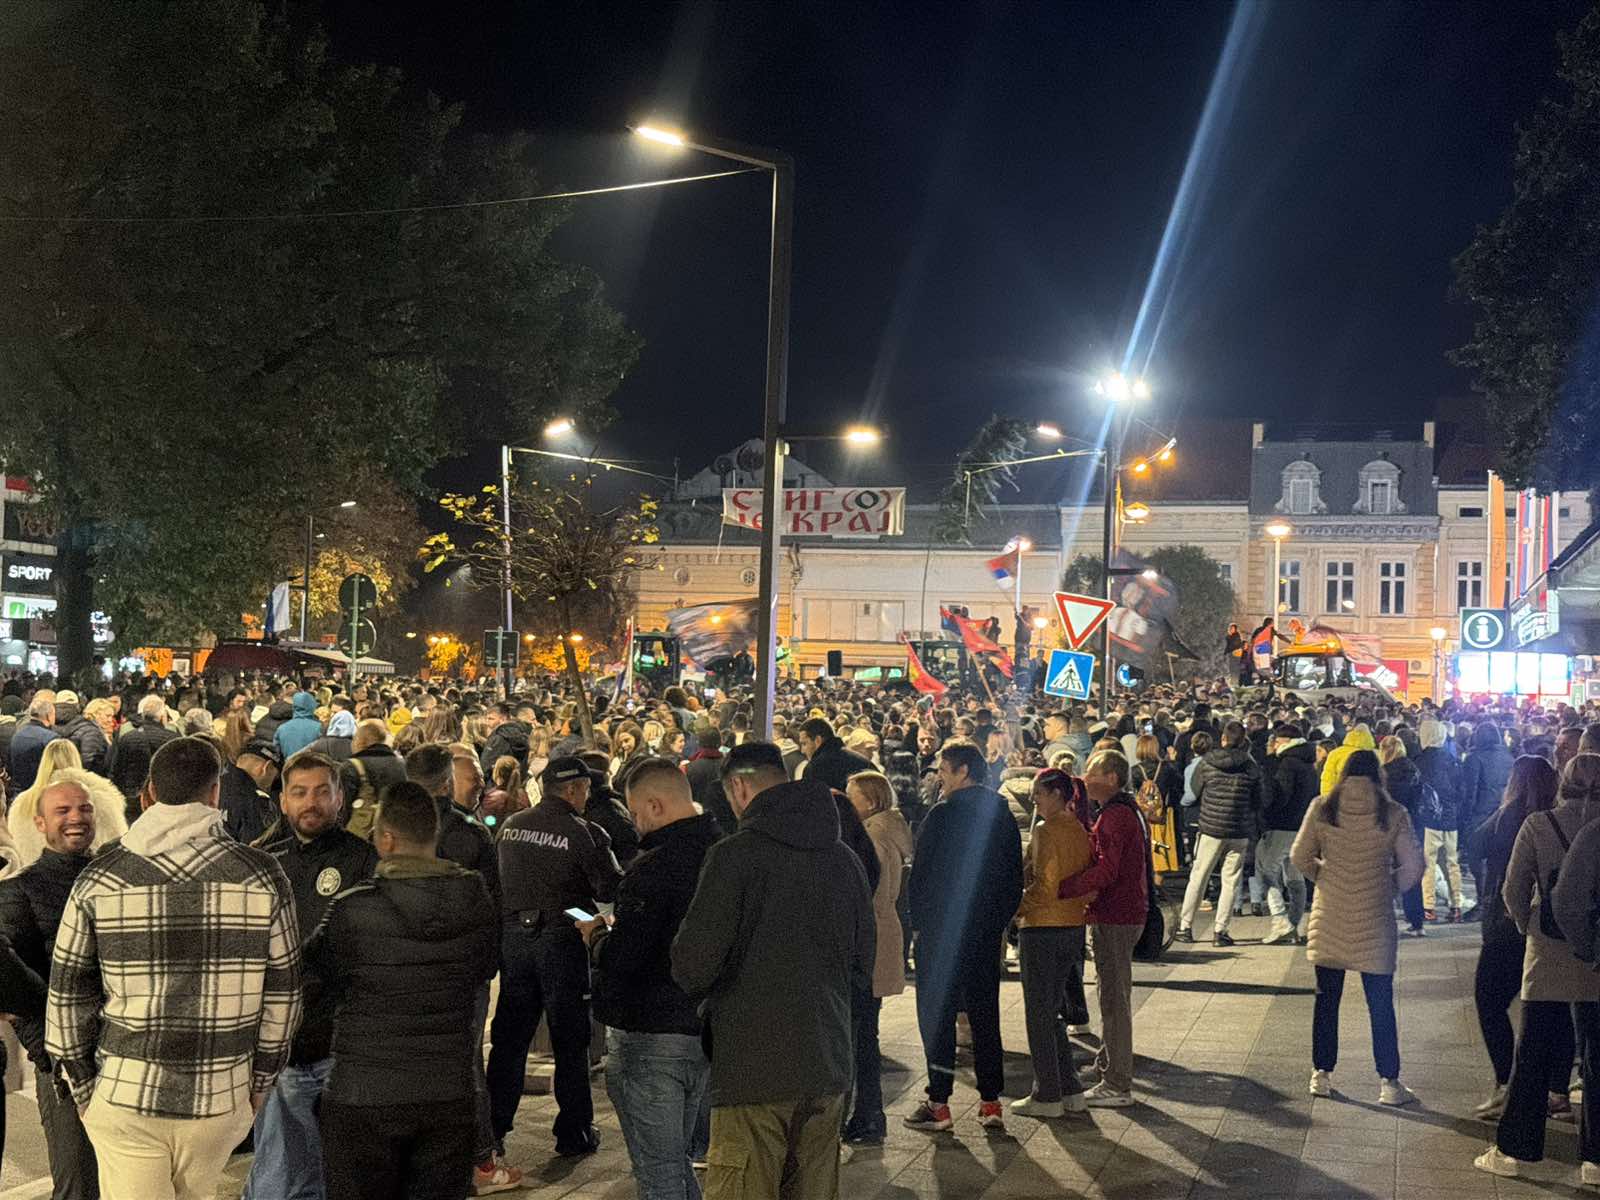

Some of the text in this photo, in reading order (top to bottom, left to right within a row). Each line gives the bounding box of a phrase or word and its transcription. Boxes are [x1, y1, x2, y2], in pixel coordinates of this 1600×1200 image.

[791, 511, 890, 533] КРАЈ
[8, 565, 53, 581] SPORT
[502, 828, 569, 851] ПОЛИЦИЈА
